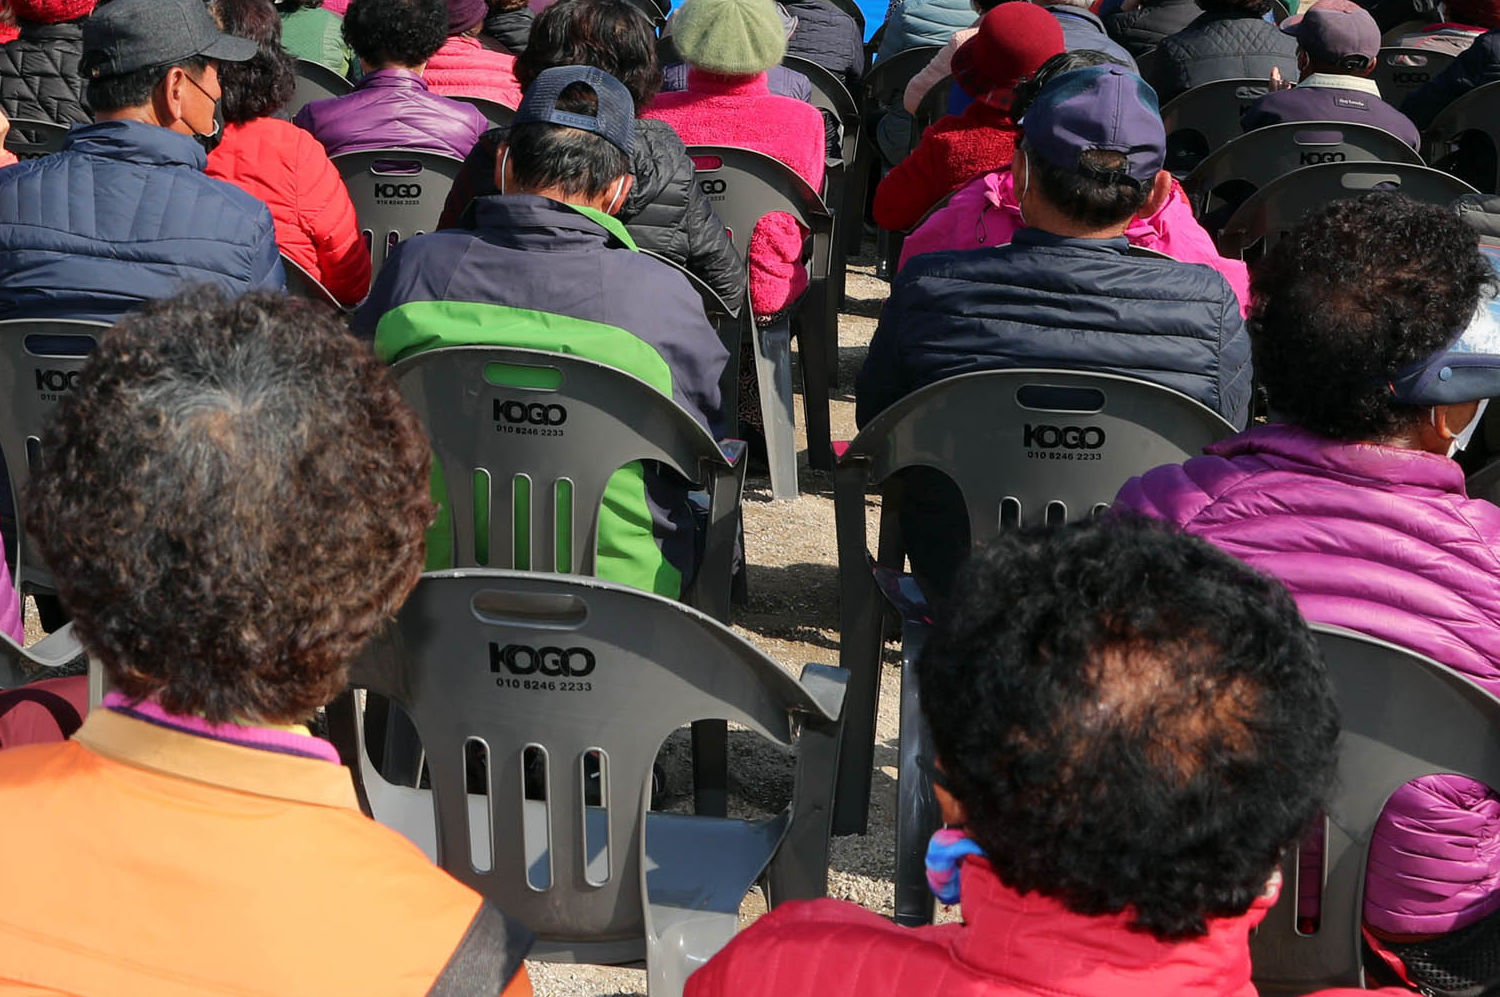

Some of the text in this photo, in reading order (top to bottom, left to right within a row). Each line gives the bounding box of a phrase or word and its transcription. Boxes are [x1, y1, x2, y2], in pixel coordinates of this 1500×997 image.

[374, 182, 422, 199] KOGO
[493, 398, 567, 426] KOGO
[496, 424, 564, 437] 010 8246 2233
[1023, 424, 1106, 450] KOGO
[1027, 451, 1046, 459] 010
[1076, 452, 1102, 461] 2233
[489, 642, 596, 677] KOGO
[496, 677, 592, 692] 010 8246 2233
